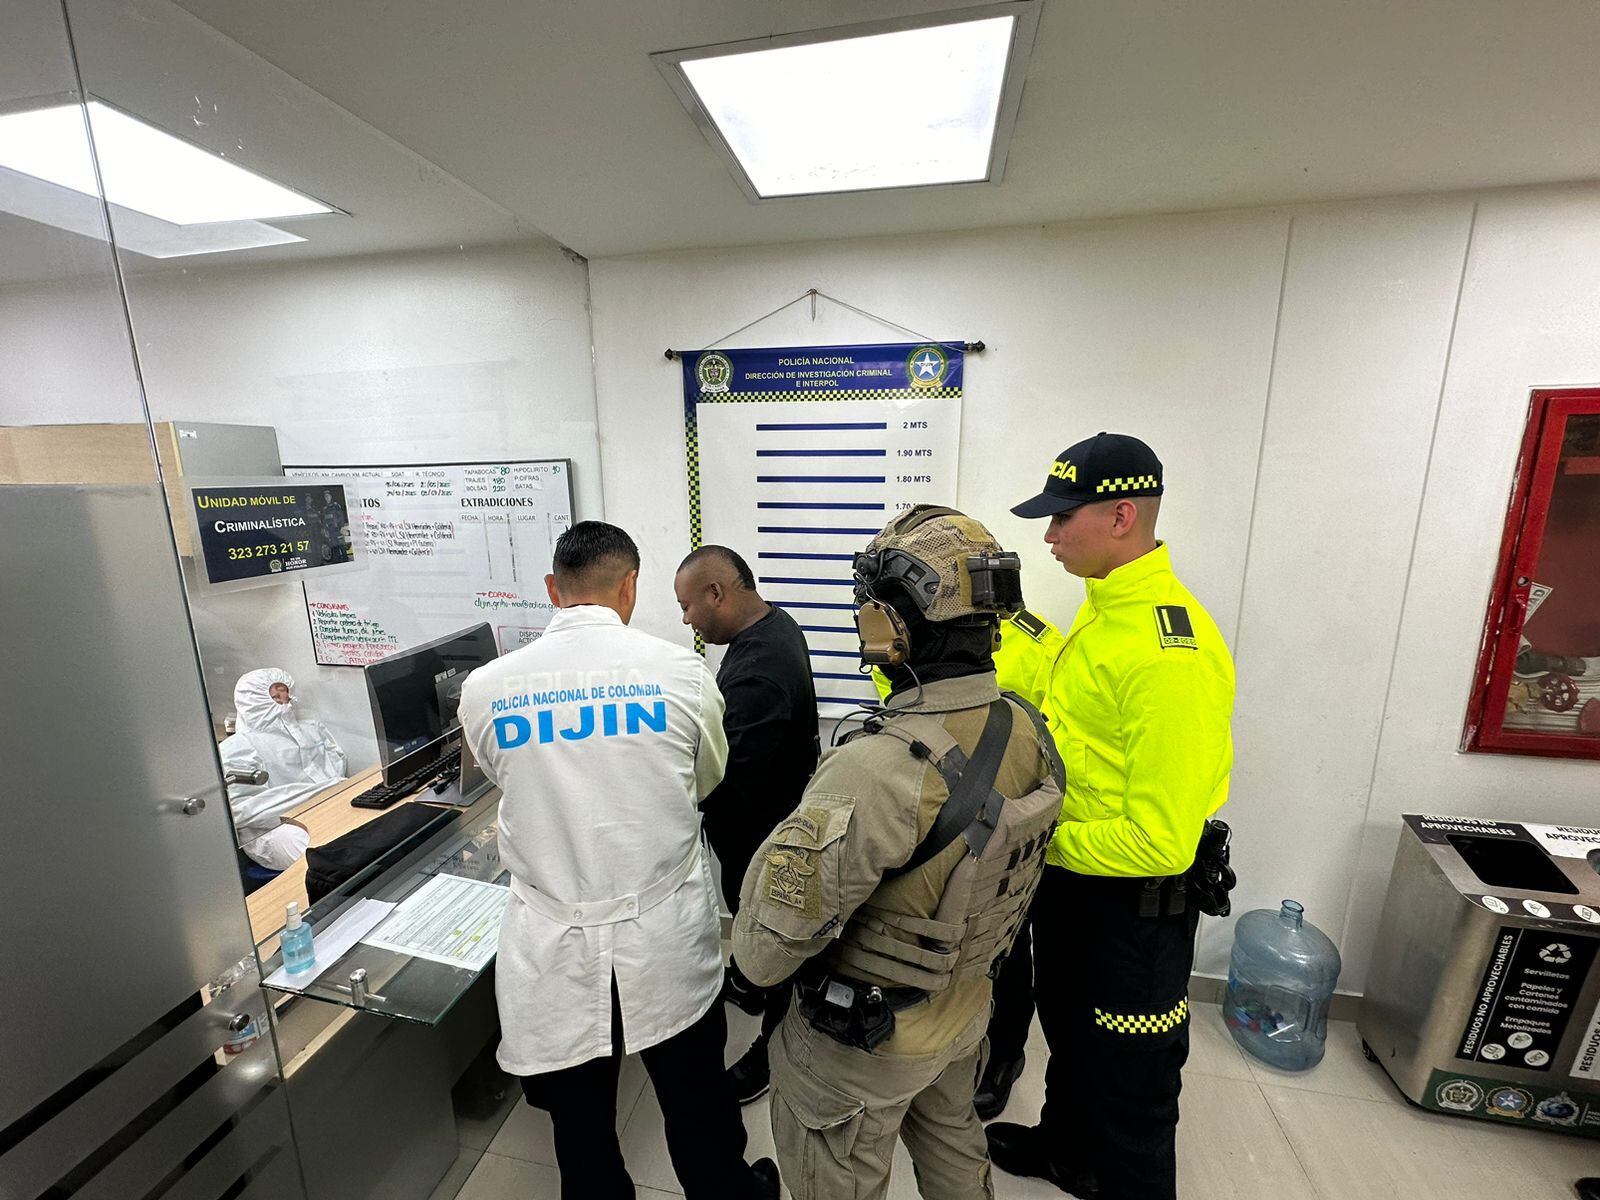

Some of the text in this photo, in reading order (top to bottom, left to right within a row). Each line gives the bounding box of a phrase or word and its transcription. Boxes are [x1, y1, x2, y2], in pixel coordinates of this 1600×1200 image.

[778, 356, 855, 366] POLICÍA NACIONAL
[745, 370, 785, 380] DIRECCIÓN
[797, 369, 855, 378] INVESTIGACIÓN
[856, 368, 893, 377] CRIMINAL
[802, 379, 840, 387] INTERPOL
[903, 421, 928, 429] 2 MTS
[197, 494, 297, 509] UNIDAD MÓVIL DE
[461, 497, 534, 507] EXTRADICIONES
[214, 516, 306, 534] CRIMINALÍSTICA
[228, 540, 310, 560] 323 273 21 57
[533, 687, 589, 706] NACIONAL
[591, 686, 605, 699] DE
[608, 684, 662, 698] COLOMBIA
[492, 701, 667, 750] DIJIN
[1420, 821, 1516, 836] APROVECHABLES
[1524, 968, 1570, 980] Servilletas
[1520, 982, 1555, 992] Papeles
[1463, 934, 1514, 1054] RESIDUOS NO APROVECHABLES
[1519, 989, 1559, 1000] Cartones
[1504, 995, 1568, 1009] contaminados
[1526, 1005, 1560, 1015] comida
[1504, 1016, 1551, 1028] Empaques
[1500, 1022, 1552, 1035] Metalizados
